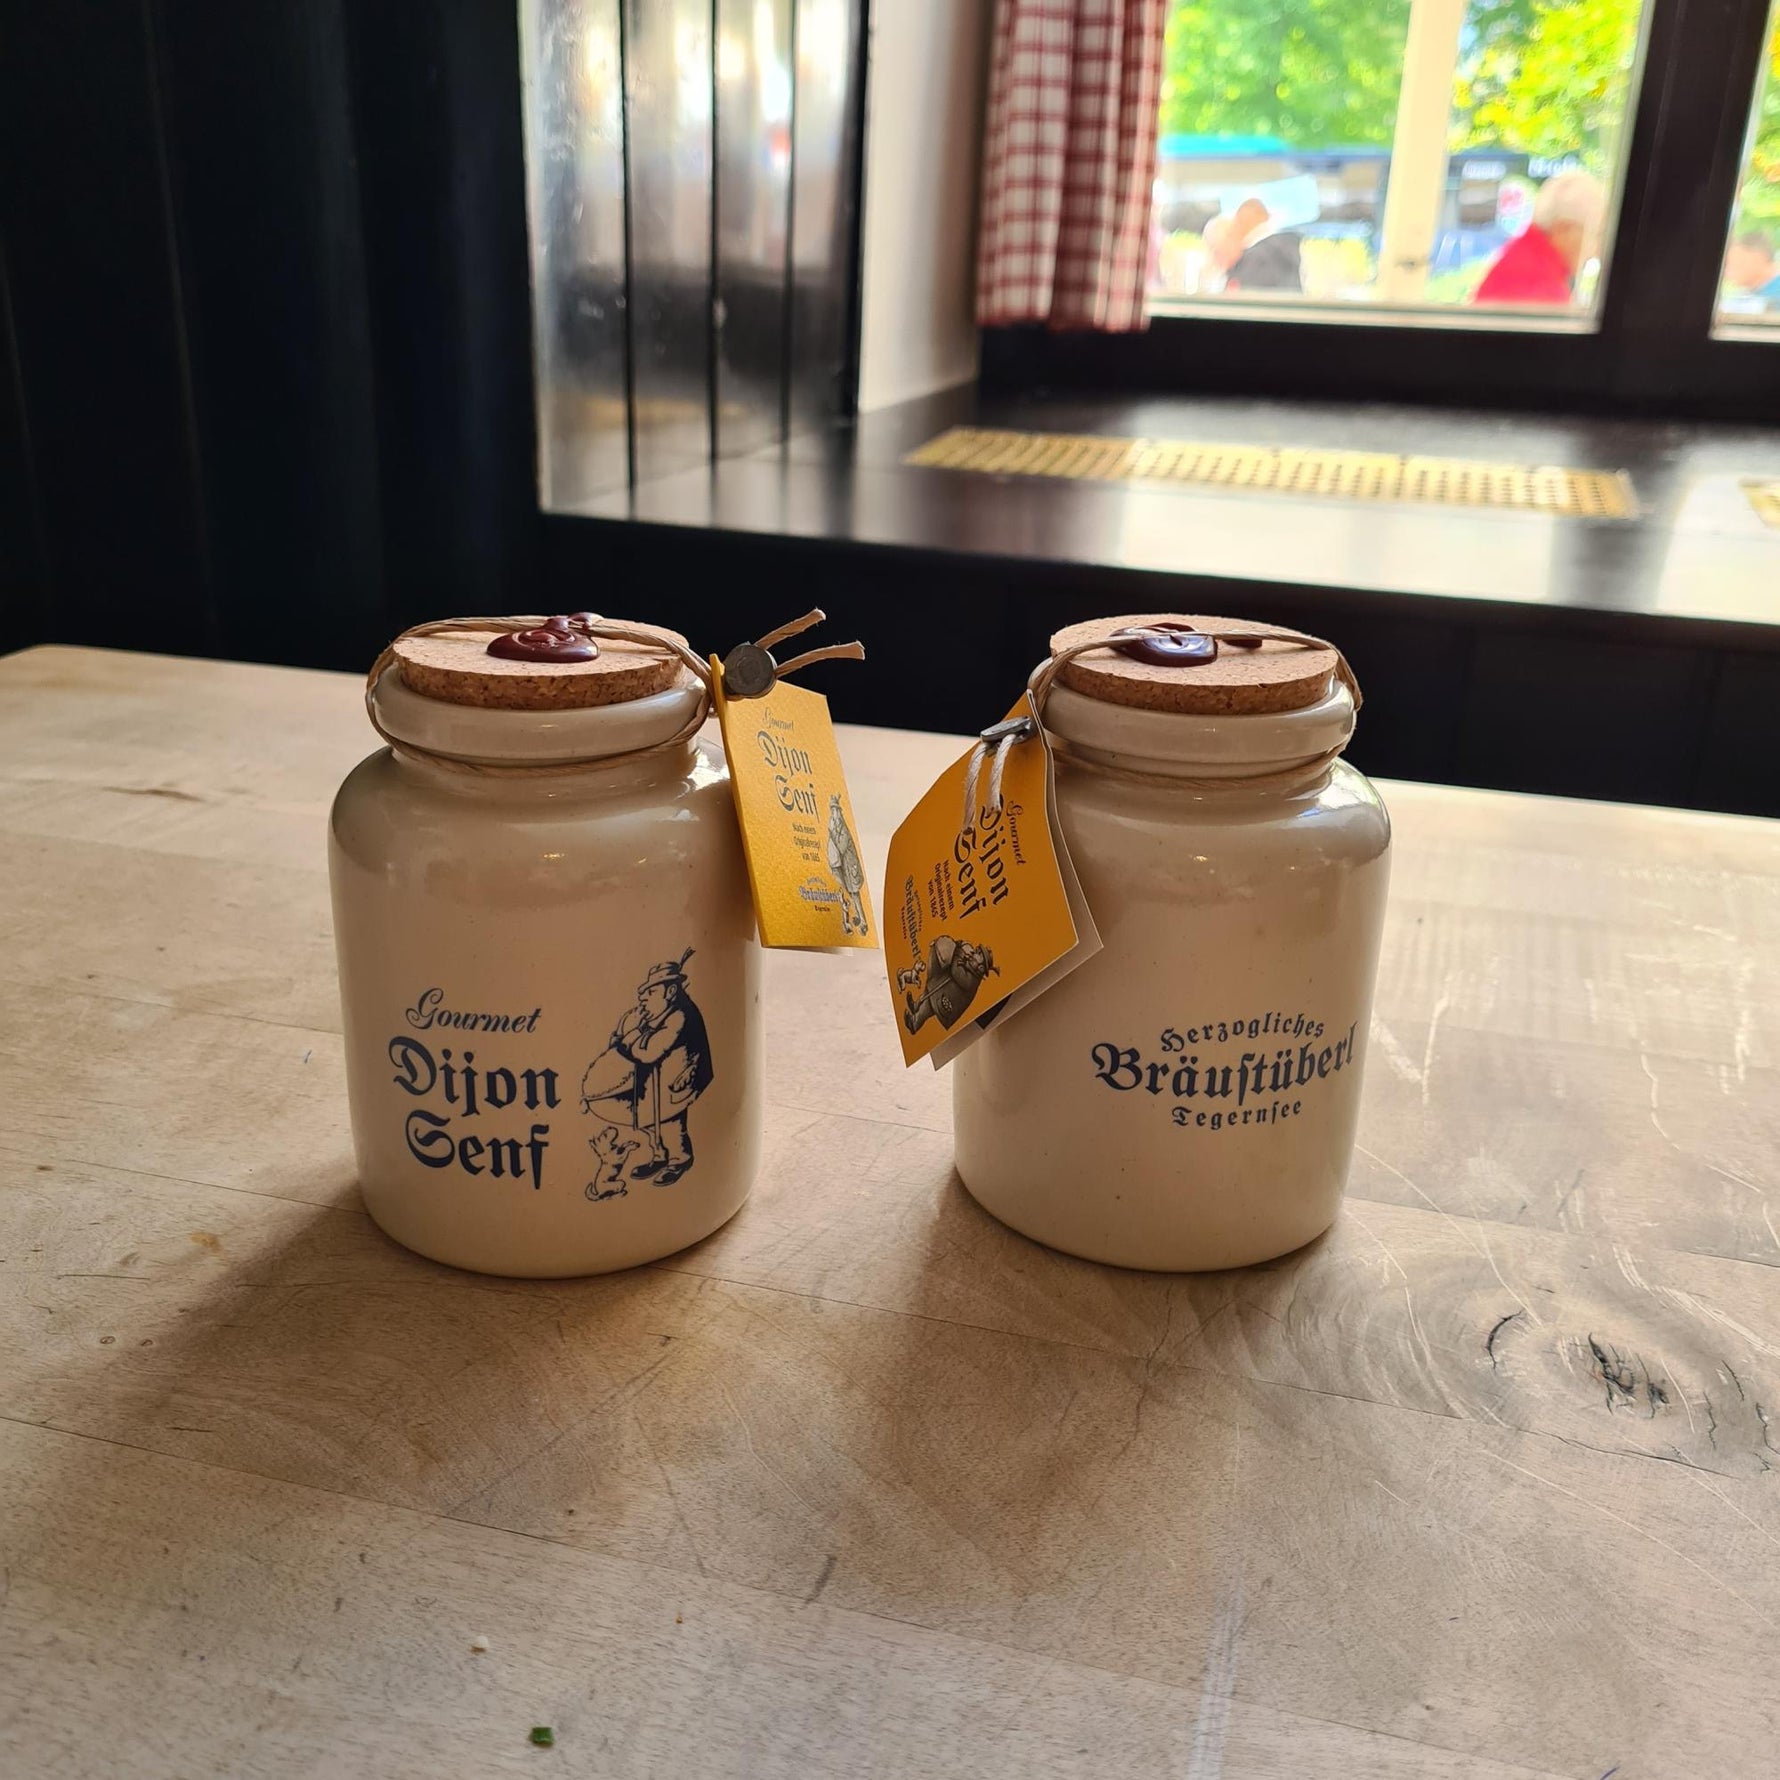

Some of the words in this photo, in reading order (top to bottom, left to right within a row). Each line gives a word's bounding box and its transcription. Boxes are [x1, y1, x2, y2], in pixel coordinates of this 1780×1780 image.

[763, 706, 794, 731] Gourmet
[757, 730, 813, 777] Dijon
[775, 774, 820, 823] Senf
[1006, 800, 1027, 866] Gourmet
[954, 827, 987, 919] Senf
[405, 988, 542, 1033] Gourmet
[1160, 1012, 1325, 1052] Herzogliches
[388, 1035, 562, 1117] Dijon
[405, 1109, 550, 1190] Senf
